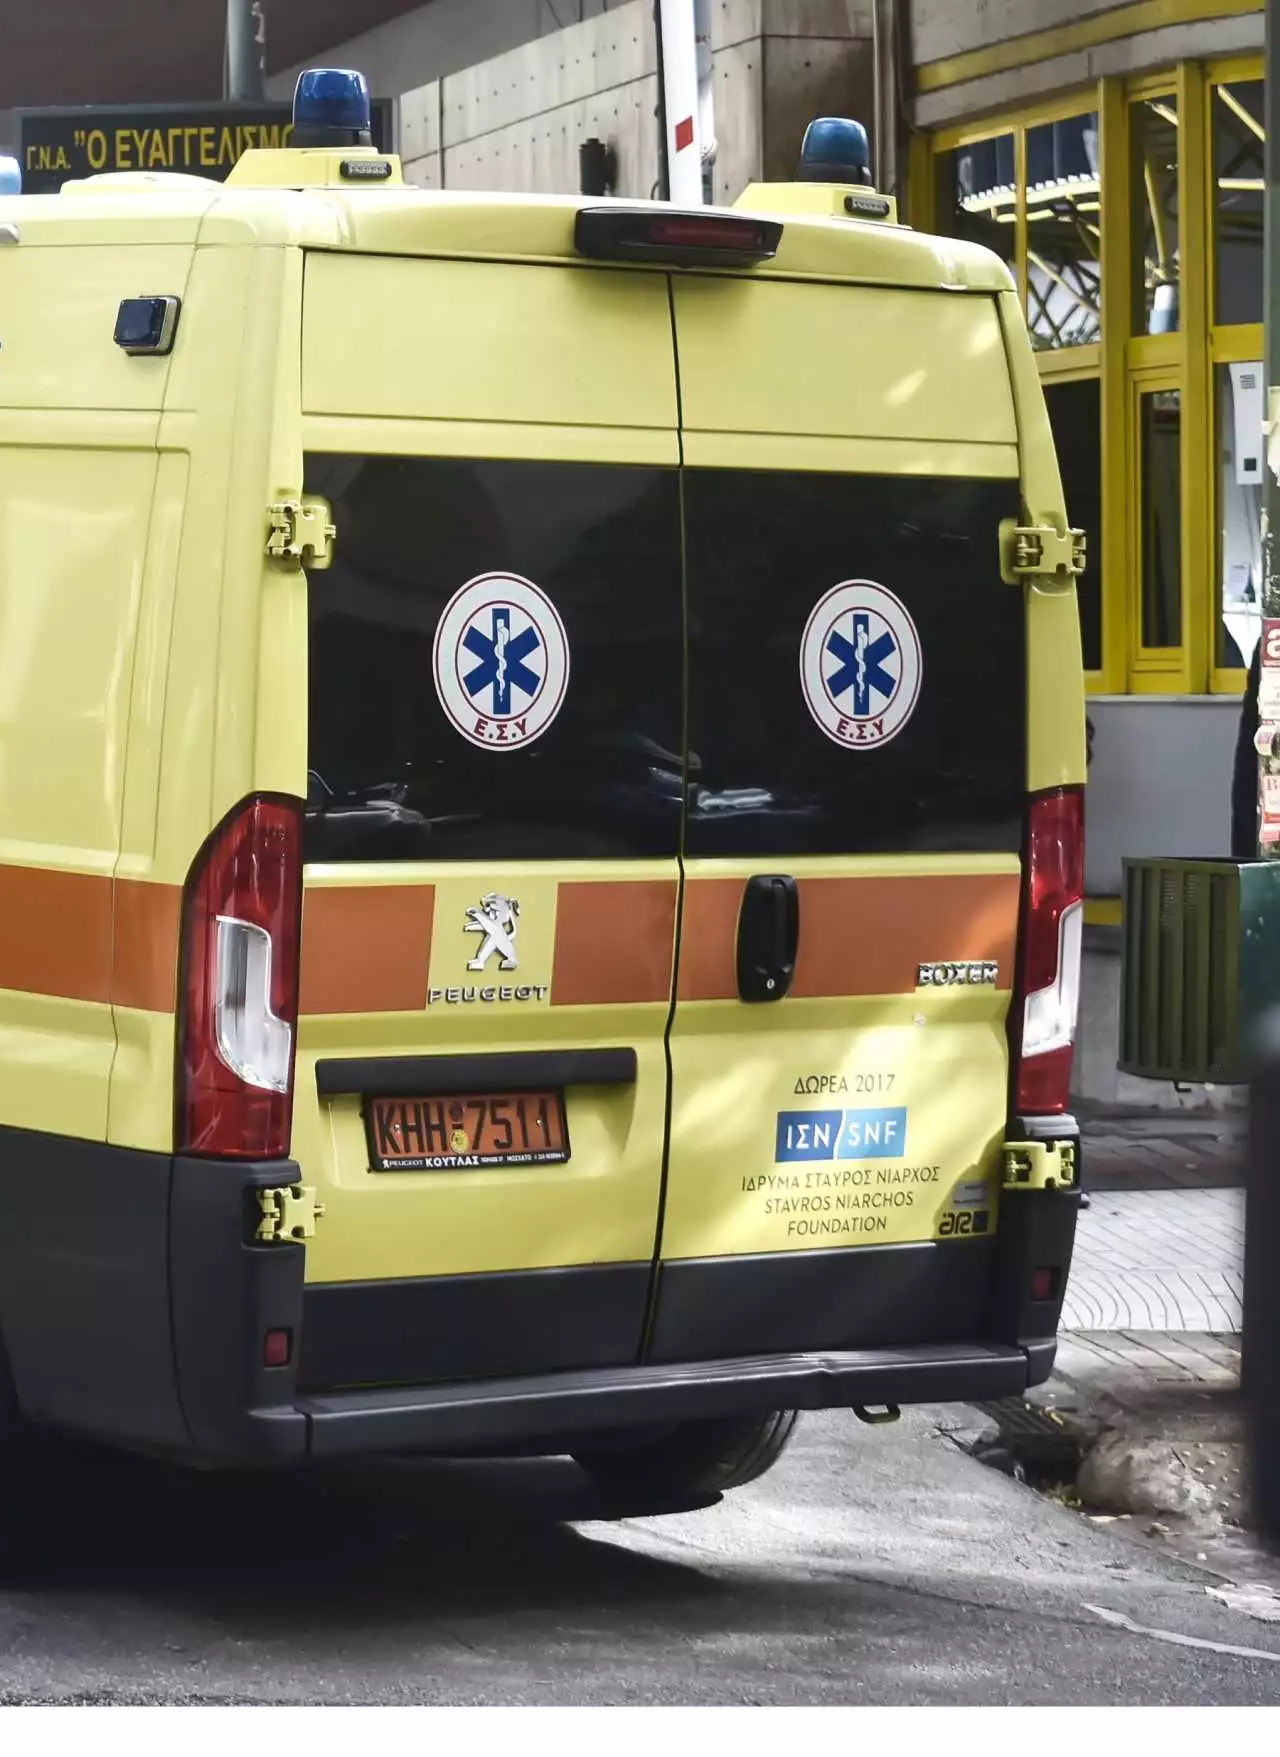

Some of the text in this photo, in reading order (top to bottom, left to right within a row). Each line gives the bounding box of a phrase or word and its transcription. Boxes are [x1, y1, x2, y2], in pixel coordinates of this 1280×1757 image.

[27, 146, 71, 170] Γ.Ν.Α.
[473, 718, 528, 741] Ε.Σ.Υ
[836, 718, 885, 740] Ε.Σ.Υ
[917, 963, 999, 987] BOXER
[428, 985, 548, 1005] PEUGEOT
[794, 1074, 896, 1094] ΔΩΡΕΑ 2017
[787, 1122, 831, 1149] ΙΣΝ
[847, 1120, 898, 1147] SNF
[425, 1156, 480, 1169] ΚΟΥΤΛΑΣ
[741, 1166, 940, 1192] ΙΔΡΥΜΑ ΣΤΑΥΡΟΣ ΝΙΑΡΧΟΣ
[764, 1191, 914, 1214] STAVROS NIARCHOS
[787, 1215, 888, 1236] FOUNDATION
